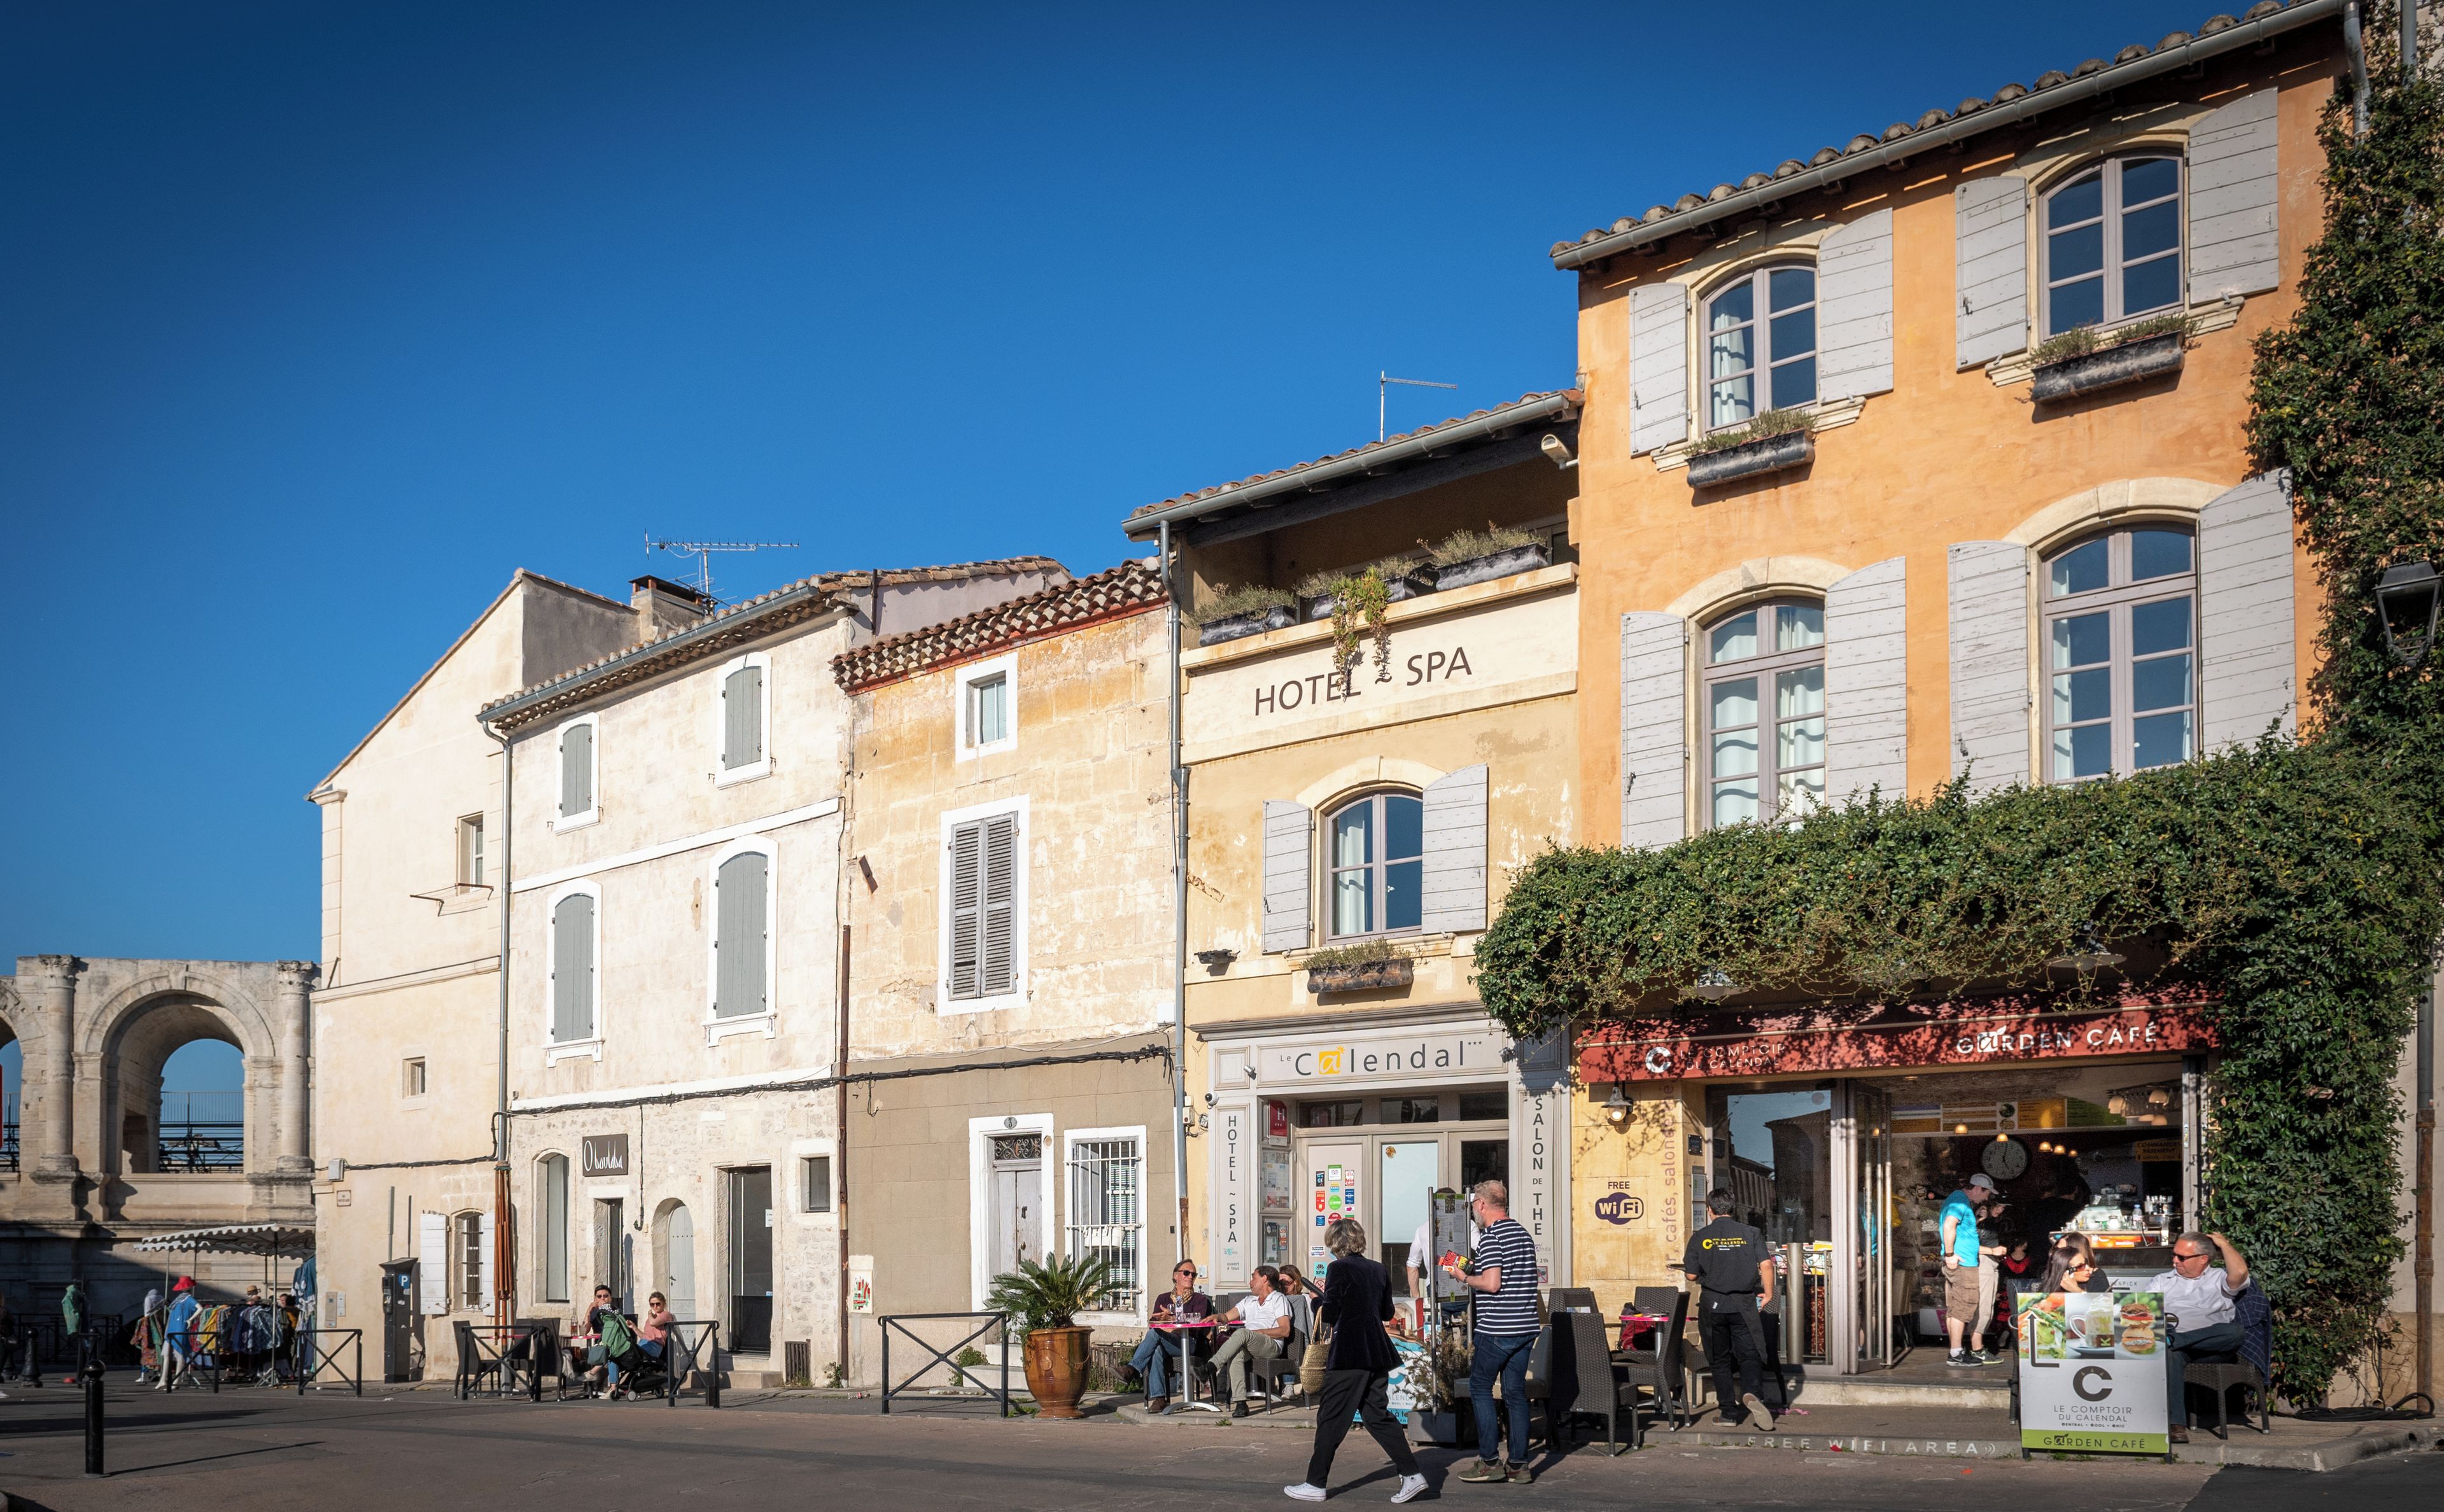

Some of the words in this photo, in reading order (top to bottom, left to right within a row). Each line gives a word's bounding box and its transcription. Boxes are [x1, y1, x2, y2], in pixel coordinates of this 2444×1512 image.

[1255, 670, 1361, 716] HOTEL
[1406, 647, 1472, 686] SPA
[2086, 1021, 2157, 1046] CAFÉ
[1295, 1041, 1464, 1076] Calendal
[1680, 1049, 1694, 1060] LE
[1703, 1044, 1785, 1059] COMPTOIR
[1687, 1061, 1703, 1070] DU
[1710, 1056, 1780, 1069] CALENDAL
[1008, 1117, 1013, 1128] 3
[1277, 1108, 1286, 1121] H
[1532, 1098, 1545, 1170] SALON
[583, 1140, 593, 1172] O
[1227, 1115, 1237, 1182] HOTEL
[1608, 1181, 1631, 1189] FREE
[1533, 1193, 1543, 1236] THE
[1598, 1201, 1639, 1215] WiFi
[1228, 1203, 1237, 1243] SPA
[401, 1275, 409, 1287] P
[2070, 1405, 2132, 1415] COMPTOIR
[2075, 1414, 2128, 1422] CALENDAL
[1748, 1436, 1811, 1449] FREE
[1828, 1438, 1886, 1452] WIFI
[1906, 1441, 1979, 1454] AREA
[2110, 1438, 2146, 1449] CAFÉ
